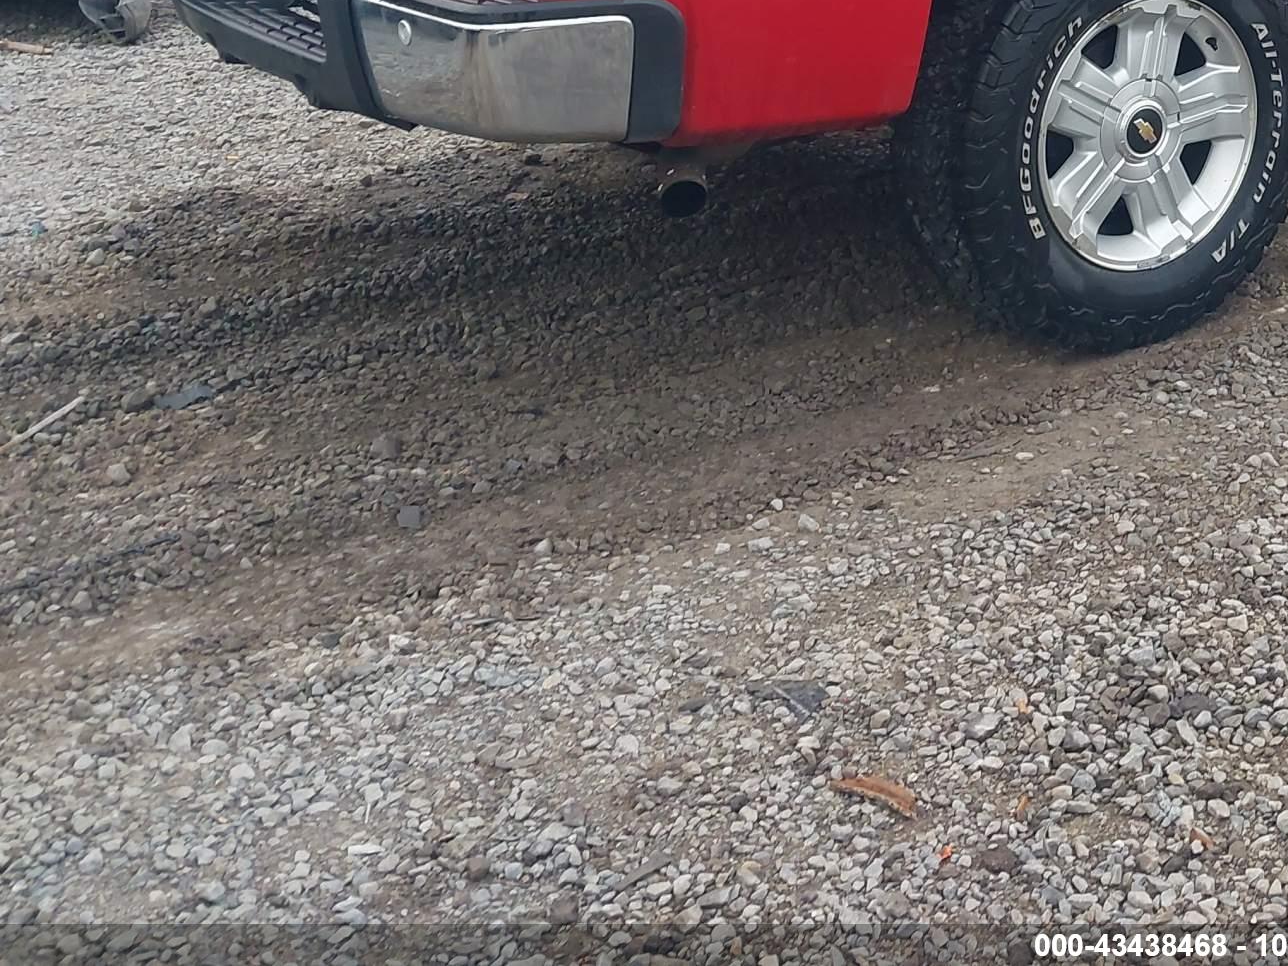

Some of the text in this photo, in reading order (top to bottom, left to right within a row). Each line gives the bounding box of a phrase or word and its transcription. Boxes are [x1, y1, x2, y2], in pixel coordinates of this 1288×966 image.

[1019, 16, 1082, 240] BFGoodrich
[1211, 22, 1284, 263] All-Terrain T/A
